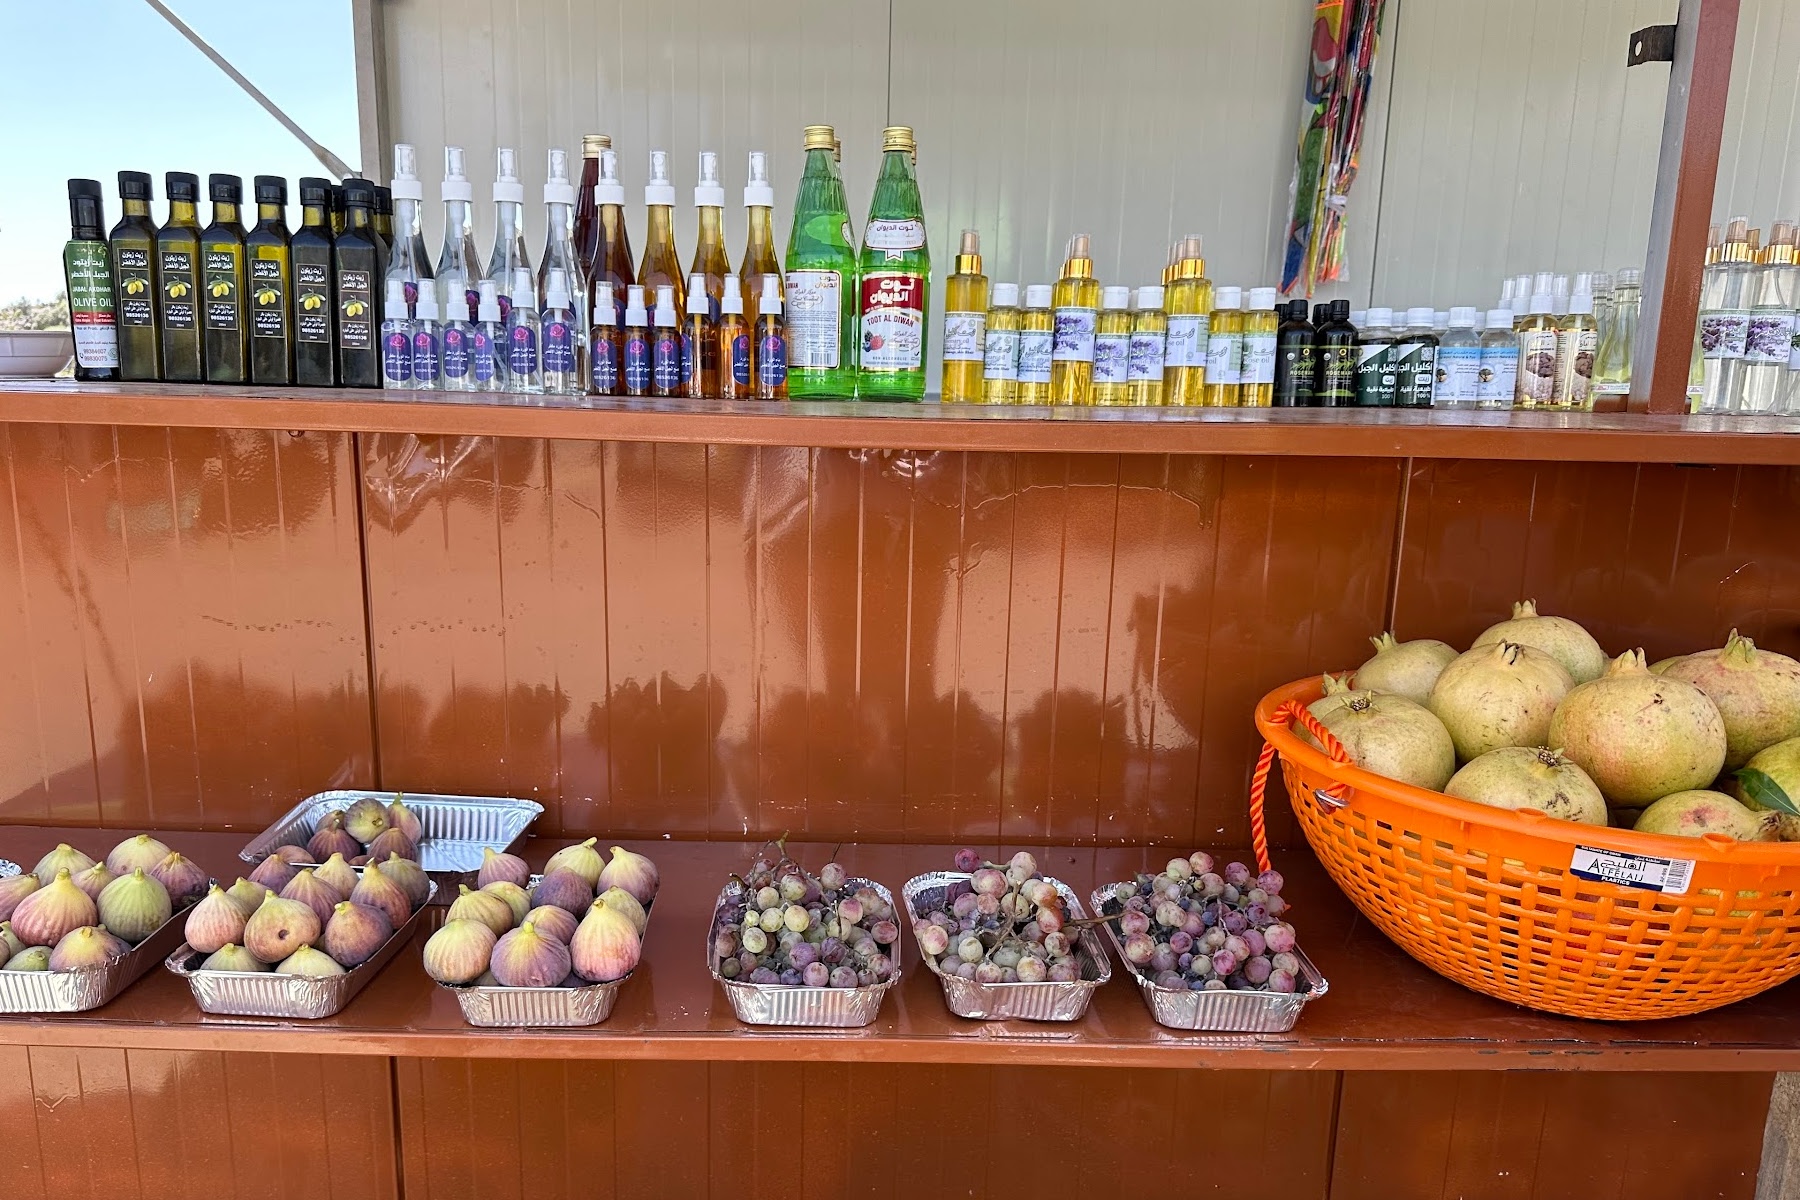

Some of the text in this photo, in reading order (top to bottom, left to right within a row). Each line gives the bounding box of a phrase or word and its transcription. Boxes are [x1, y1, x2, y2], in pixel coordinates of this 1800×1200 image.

[880, 278, 915, 292] توت
[74, 298, 114, 306] OLIVE OIL
[870, 290, 908, 304] الديوان
[867, 315, 882, 326] TOOT
[894, 316, 914, 328] DIWAN
[1358, 363, 1395, 374] كليل الجبل
[1411, 362, 1433, 373] إكليل
[1588, 858, 1643, 881] ALFELAIJ
[1601, 876, 1630, 886] PLASTICS
